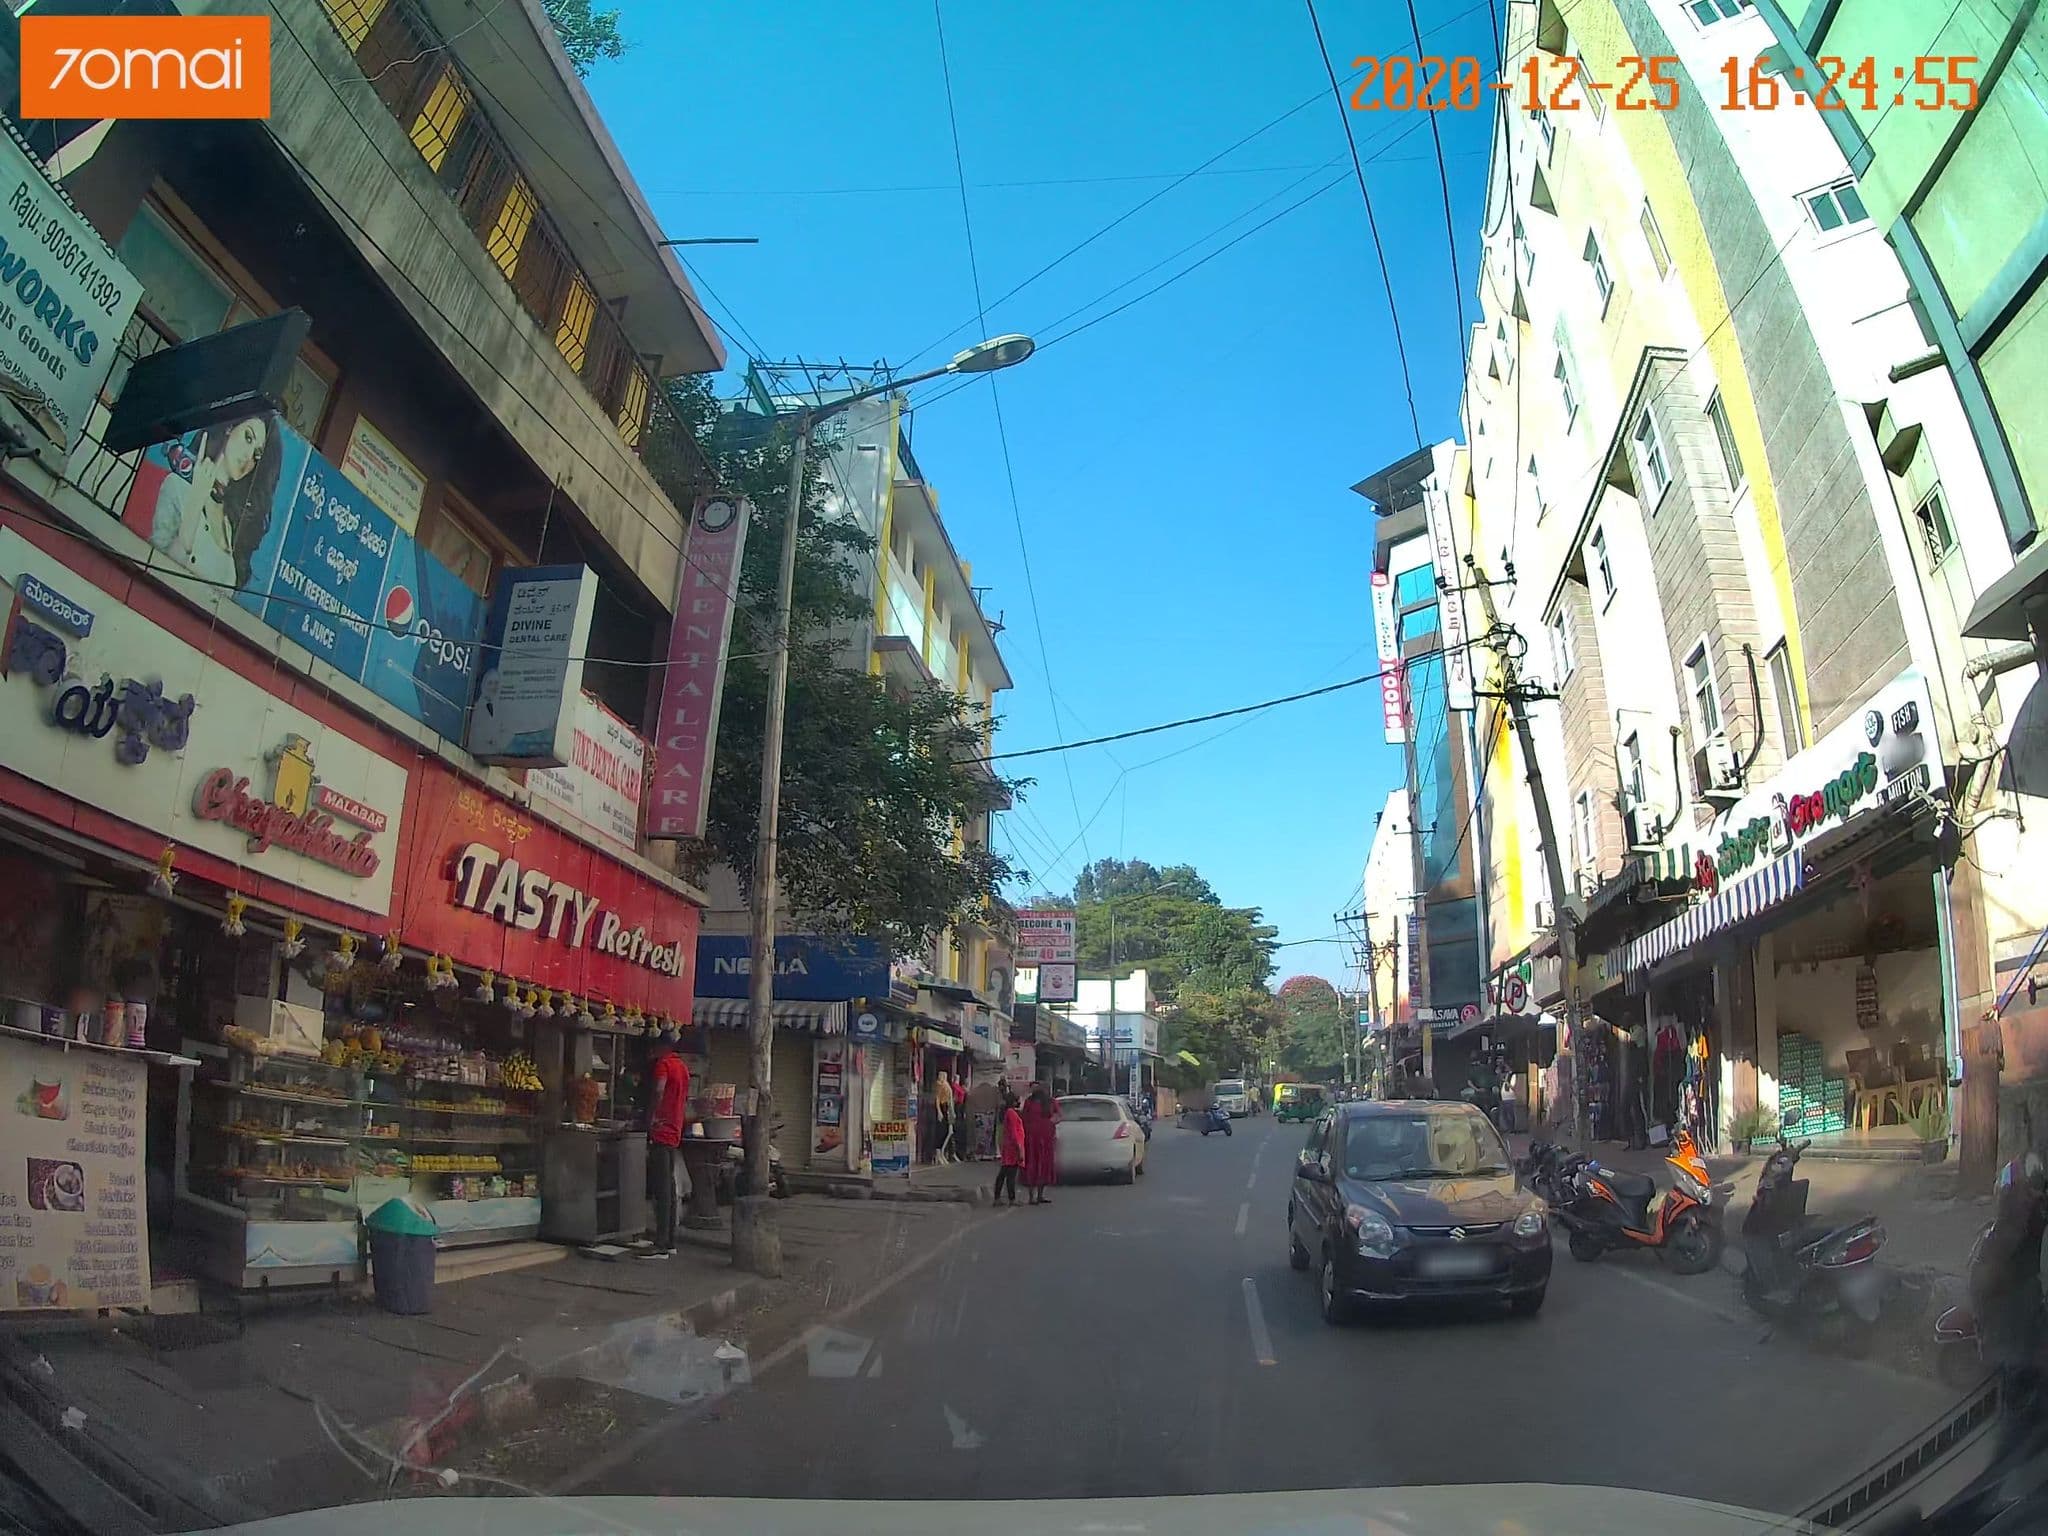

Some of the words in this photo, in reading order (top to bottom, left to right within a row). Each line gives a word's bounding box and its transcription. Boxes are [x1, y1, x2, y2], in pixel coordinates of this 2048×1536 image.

[9, 181, 46, 235] Raju:
[42, 219, 122, 317] 9036741392
[314, 535, 324, 556] &
[279, 559, 307, 592] TASTY
[304, 578, 341, 614] REFRESH
[302, 613, 311, 633] &
[310, 619, 336, 649] JUICE
[509, 634, 541, 644] DENTAL
[543, 633, 568, 643] CARE
[511, 619, 552, 632] DIVINE
[676, 572, 721, 726] DENTAL
[1892, 703, 1913, 732] FISH
[659, 735, 698, 833] CARE
[1887, 766, 1924, 801] MUTTON
[323, 790, 386, 829] MALABAR
[456, 842, 600, 949] TASTY
[597, 911, 686, 978] Refresh
[713, 957, 808, 975] NOIA
[873, 1123, 907, 1133] XEROX
